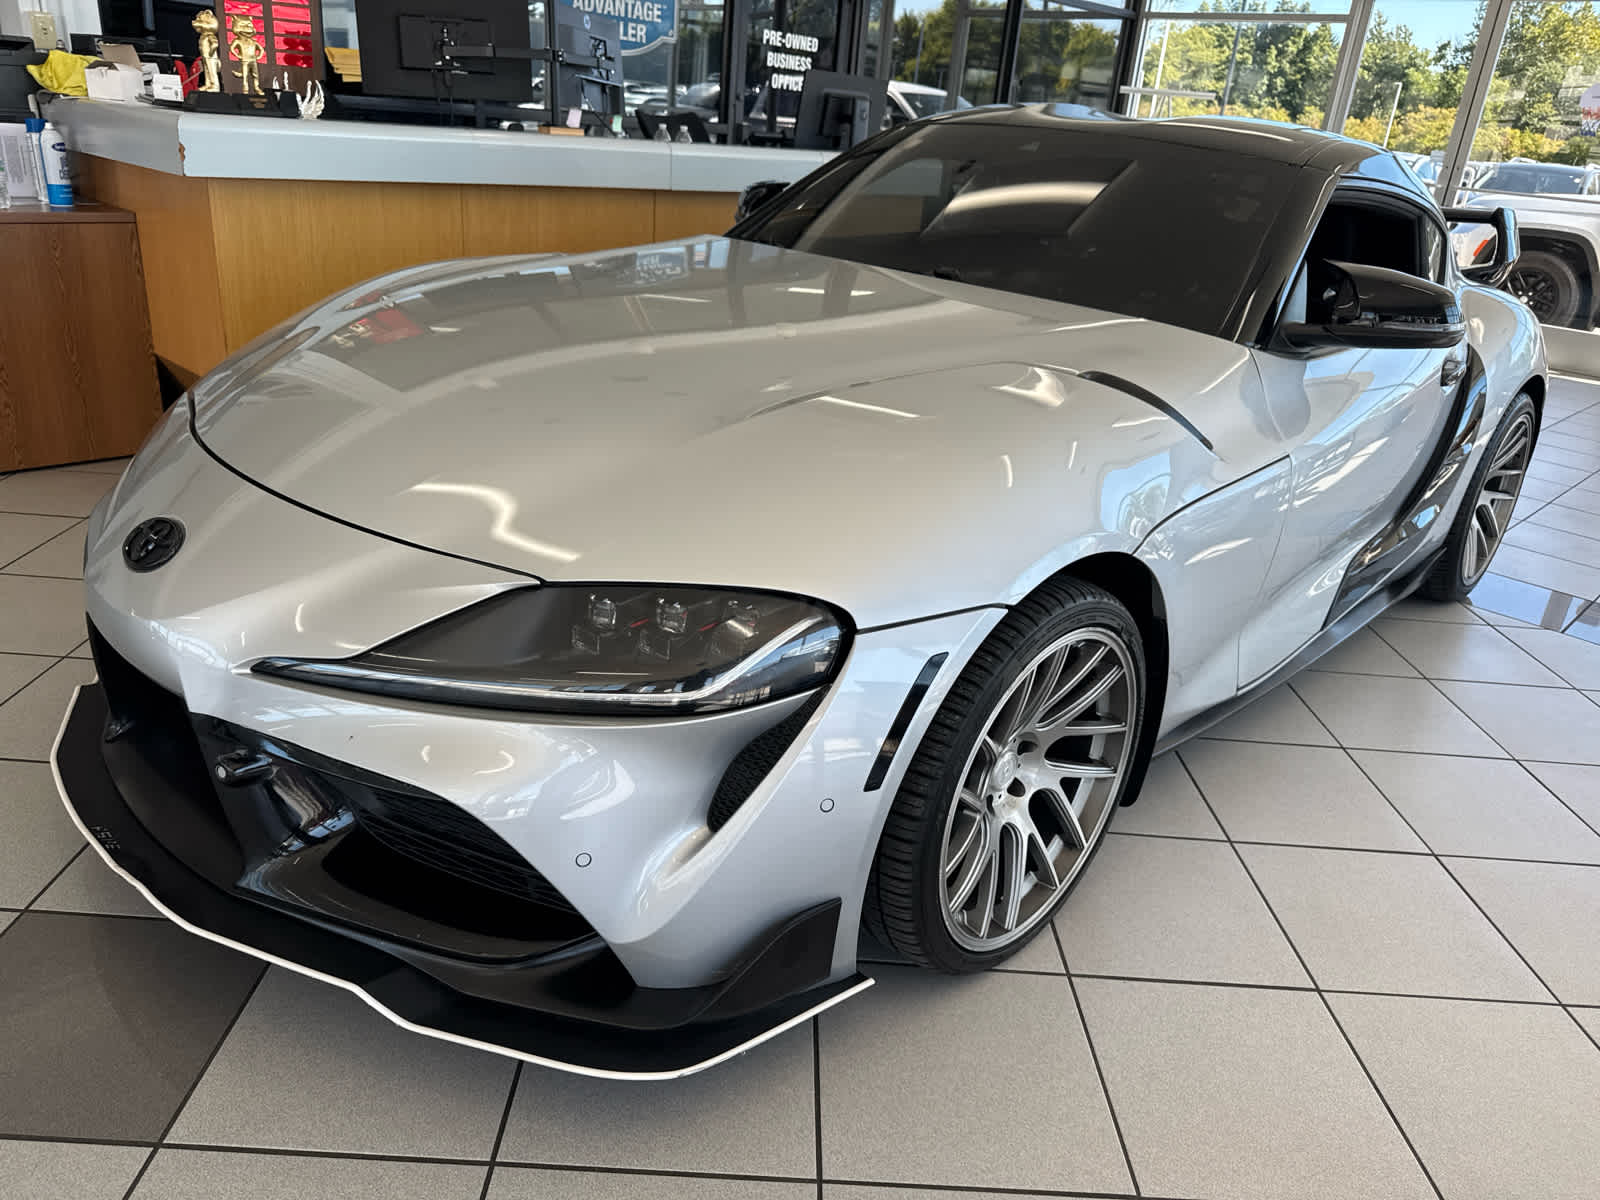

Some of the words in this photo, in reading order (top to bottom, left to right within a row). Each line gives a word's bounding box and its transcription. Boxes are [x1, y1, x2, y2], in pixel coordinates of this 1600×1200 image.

[619, 21, 647, 43] LER
[763, 28, 819, 53] PRE-OWNED
[766, 50, 813, 72] BUSINESS
[771, 73, 804, 92] OFFICE
